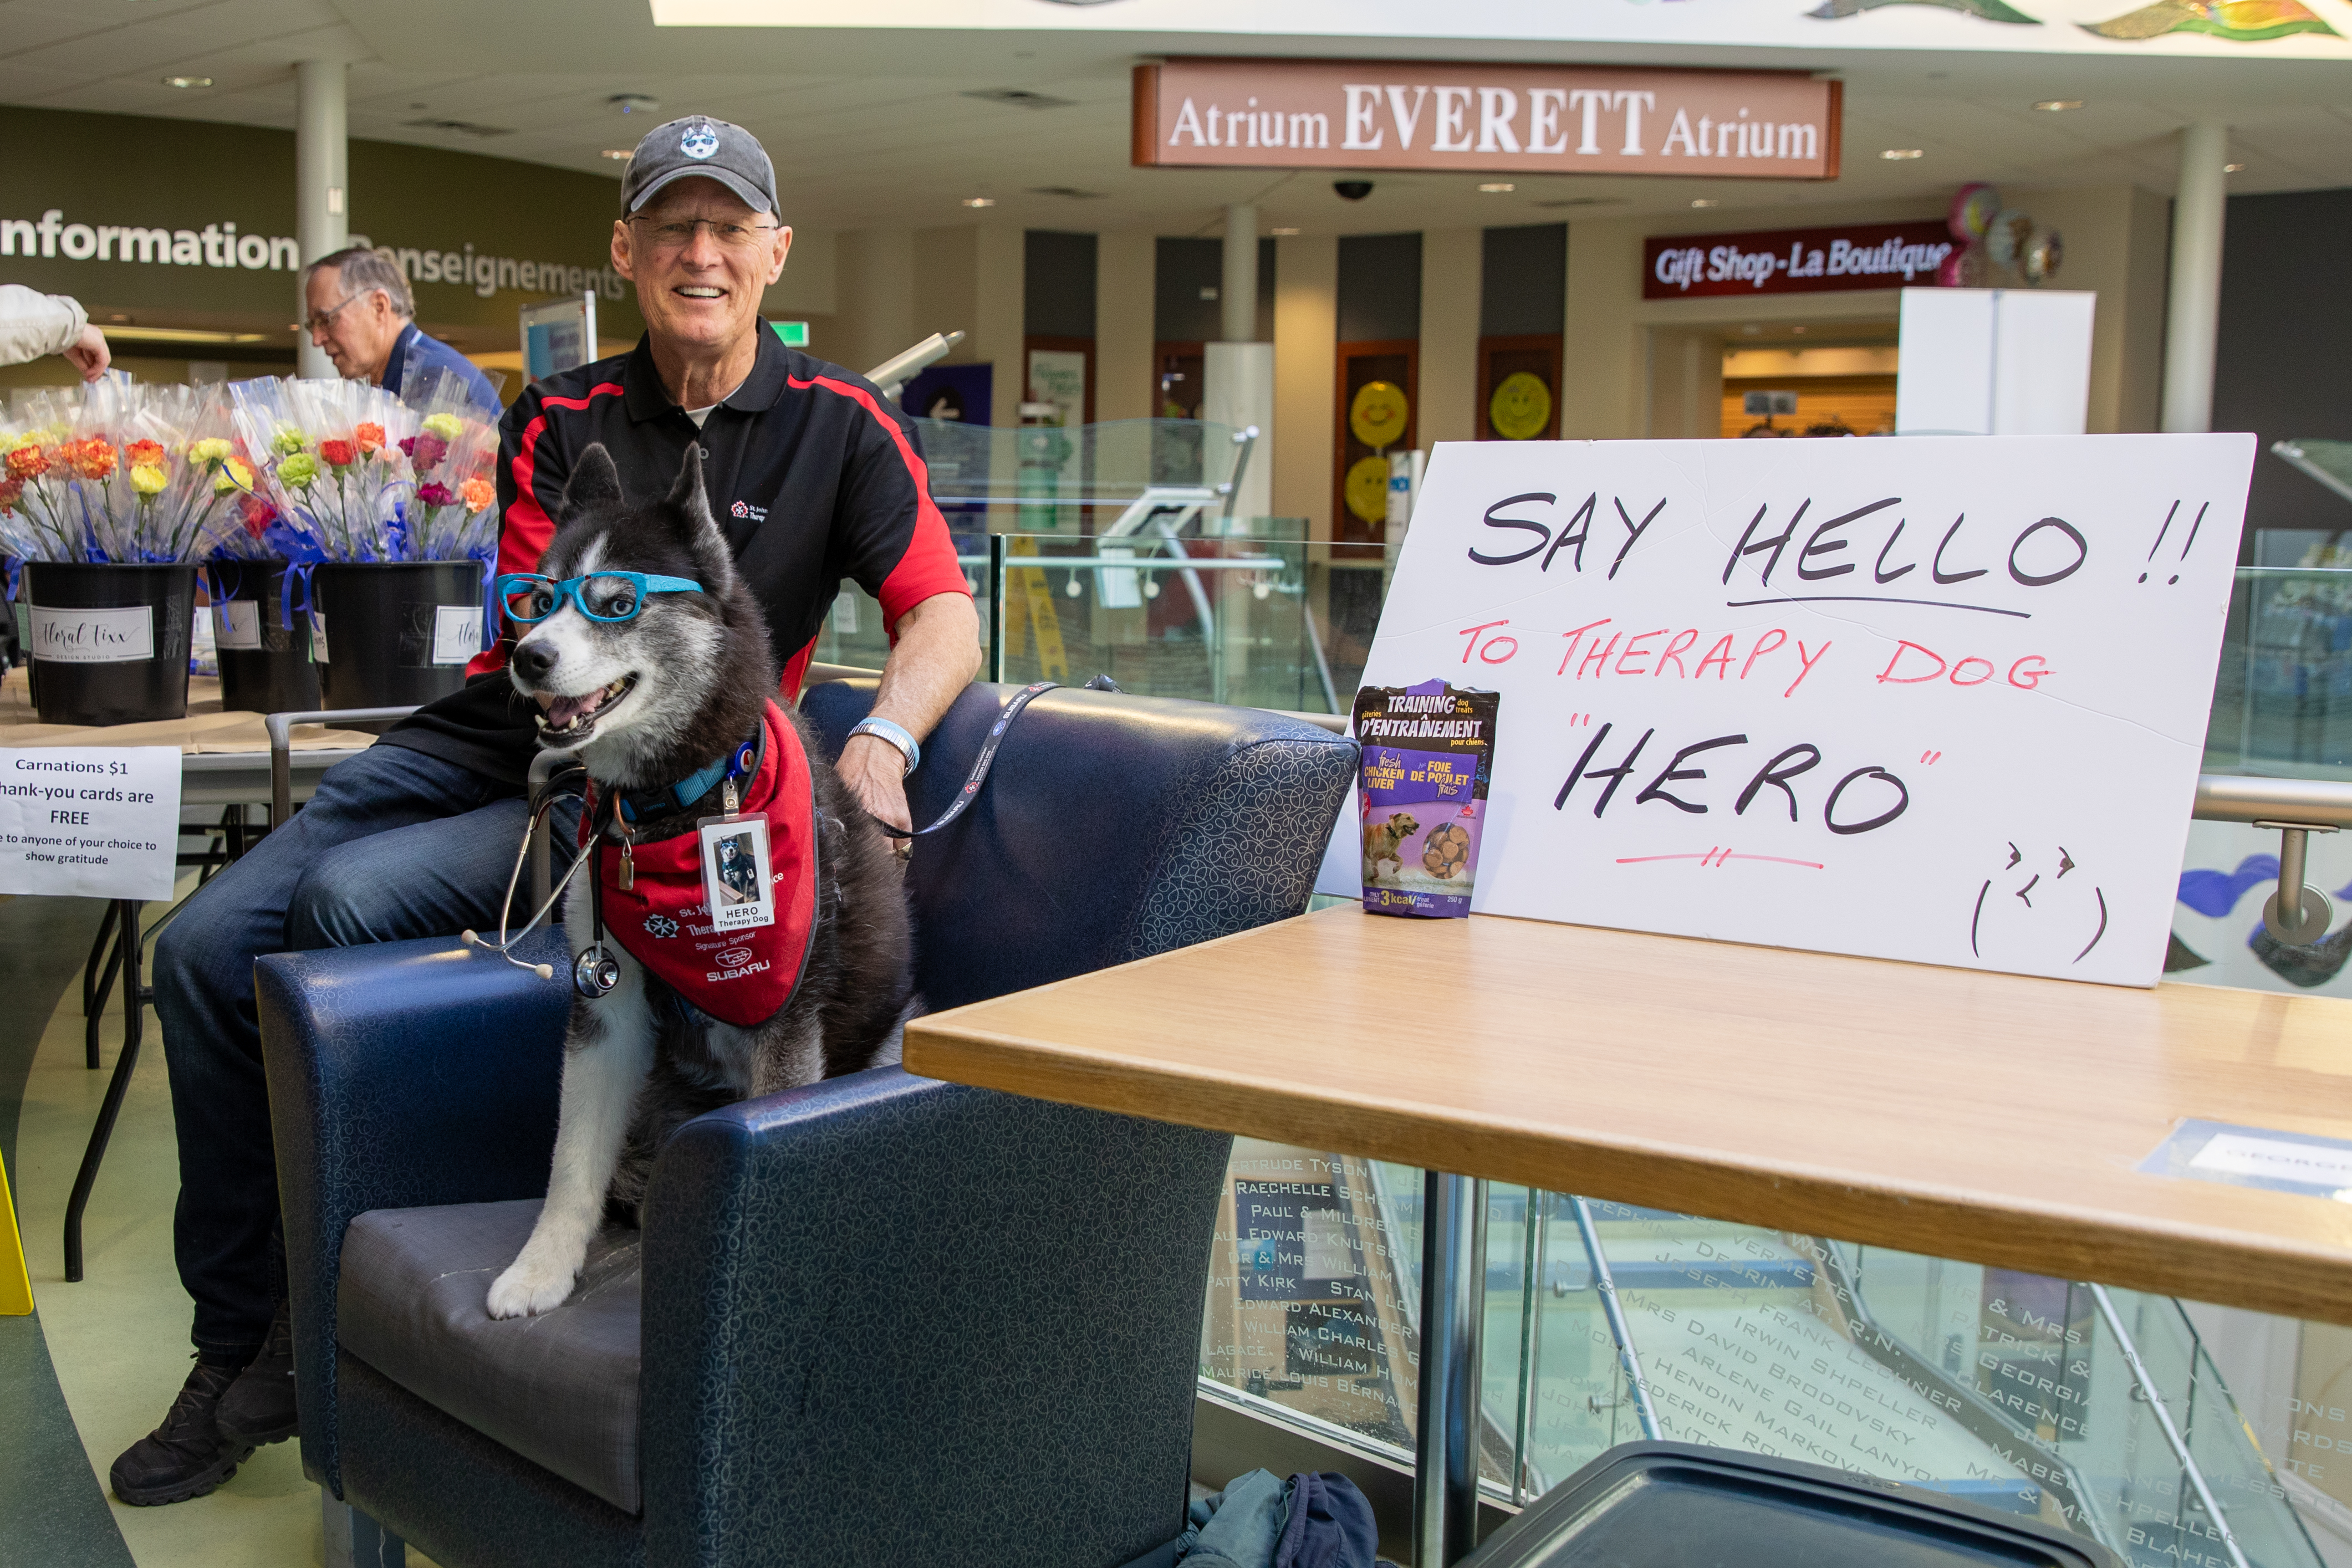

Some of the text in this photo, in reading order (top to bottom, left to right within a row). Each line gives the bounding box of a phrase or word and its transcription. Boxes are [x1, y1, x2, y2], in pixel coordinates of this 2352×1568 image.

[1167, 83, 1819, 160] Atrium EVERETT Atrium
[0, 209, 626, 300] nformation nseignements
[1655, 247, 1706, 291] Gift
[1827, 236, 1953, 281] Boutique
[1467, 491, 2211, 589] SAY HELLO !!
[1458, 616, 2057, 699] TO THERAPY DOG
[1003, 694, 1028, 719] SUBARU
[1361, 710, 1382, 720] gâteries
[1387, 696, 1469, 714] TRAINING dog
[1360, 714, 1482, 738] D'ENTRAÎNEMENT
[1450, 739, 1466, 747] pour
[16, 759, 129, 776] Carnations $1
[1378, 750, 1401, 770] fresh
[1427, 760, 1452, 773] FOIE
[1364, 766, 1405, 780] CHICKEN
[1367, 777, 1395, 790] LIVER
[1410, 770, 1470, 786] DE POULET
[1553, 711, 1942, 836] "HERO"
[0, 782, 155, 804] hank-you cards are
[1437, 777, 1459, 799] frais
[50, 810, 90, 825] FREE
[937, 801, 965, 825] SUBARU
[6, 834, 18, 844] to
[21, 835, 63, 851] anyone
[65, 837, 77, 847] of
[79, 839, 105, 850] your
[108, 839, 142, 851] choice
[145, 841, 157, 851] to
[25, 851, 109, 865] show gratitude
[1380, 890, 1390, 906] 3
[679, 908, 695, 918] St.
[718, 917, 751, 927] Therapy
[726, 906, 758, 919] HERO
[686, 925, 727, 937] Thera
[695, 931, 756, 951] Signature Sponsor
[706, 959, 771, 982] SUBARU
[1309, 1158, 1367, 1178] TYSON
[1236, 1182, 1330, 1197] RAECHELLE
[1251, 1204, 1293, 1218] PAUL
[1300, 1206, 1313, 1219] &
[1214, 1228, 1402, 1259] AUL EDWARD KNUTSO
[1258, 1251, 1272, 1264] &
[1278, 1253, 1314, 1266] MRS
[1322, 1256, 1392, 1280] WILLIAM
[1732, 1230, 1851, 1303] VERMETTE
[1257, 1274, 1297, 1289] KIRK
[1330, 1281, 1375, 1303] STAN
[1655, 1252, 1748, 1305] JOSEPH
[1758, 1301, 1836, 1351] FRANK
[1233, 1298, 1412, 1339] EDWARD ALEXANDER
[1988, 1298, 2008, 1317] &
[2022, 1310, 2081, 1345] MRS
[1244, 1320, 1309, 1338] WILLIAM
[1317, 1327, 1398, 1359] CHARLES
[1847, 1319, 1901, 1356] R.N.
[1950, 1310, 2059, 1367] PATRICK
[2069, 1360, 2090, 1378] &
[1298, 1347, 1368, 1374] WILLIAM
[1625, 1290, 1676, 1324] MRS
[1686, 1319, 1758, 1365] DAVID
[1768, 1362, 1916, 1446] BRODOVSKY
[1201, 1366, 1276, 1380] MAURICE
[1279, 1369, 1328, 1388] LOUIS
[1654, 1356, 1744, 1413] HENDIN
[1733, 1316, 1937, 1431] IRWIN SHPELLER
[1608, 1362, 1732, 1434] FREDERICK
[1954, 1371, 2091, 1437] CLARENCE
[1681, 1347, 1950, 1493] ARLENE GAIL LANYON
[1991, 1442, 2079, 1493] MABEL
[2017, 1486, 2038, 1504] &
